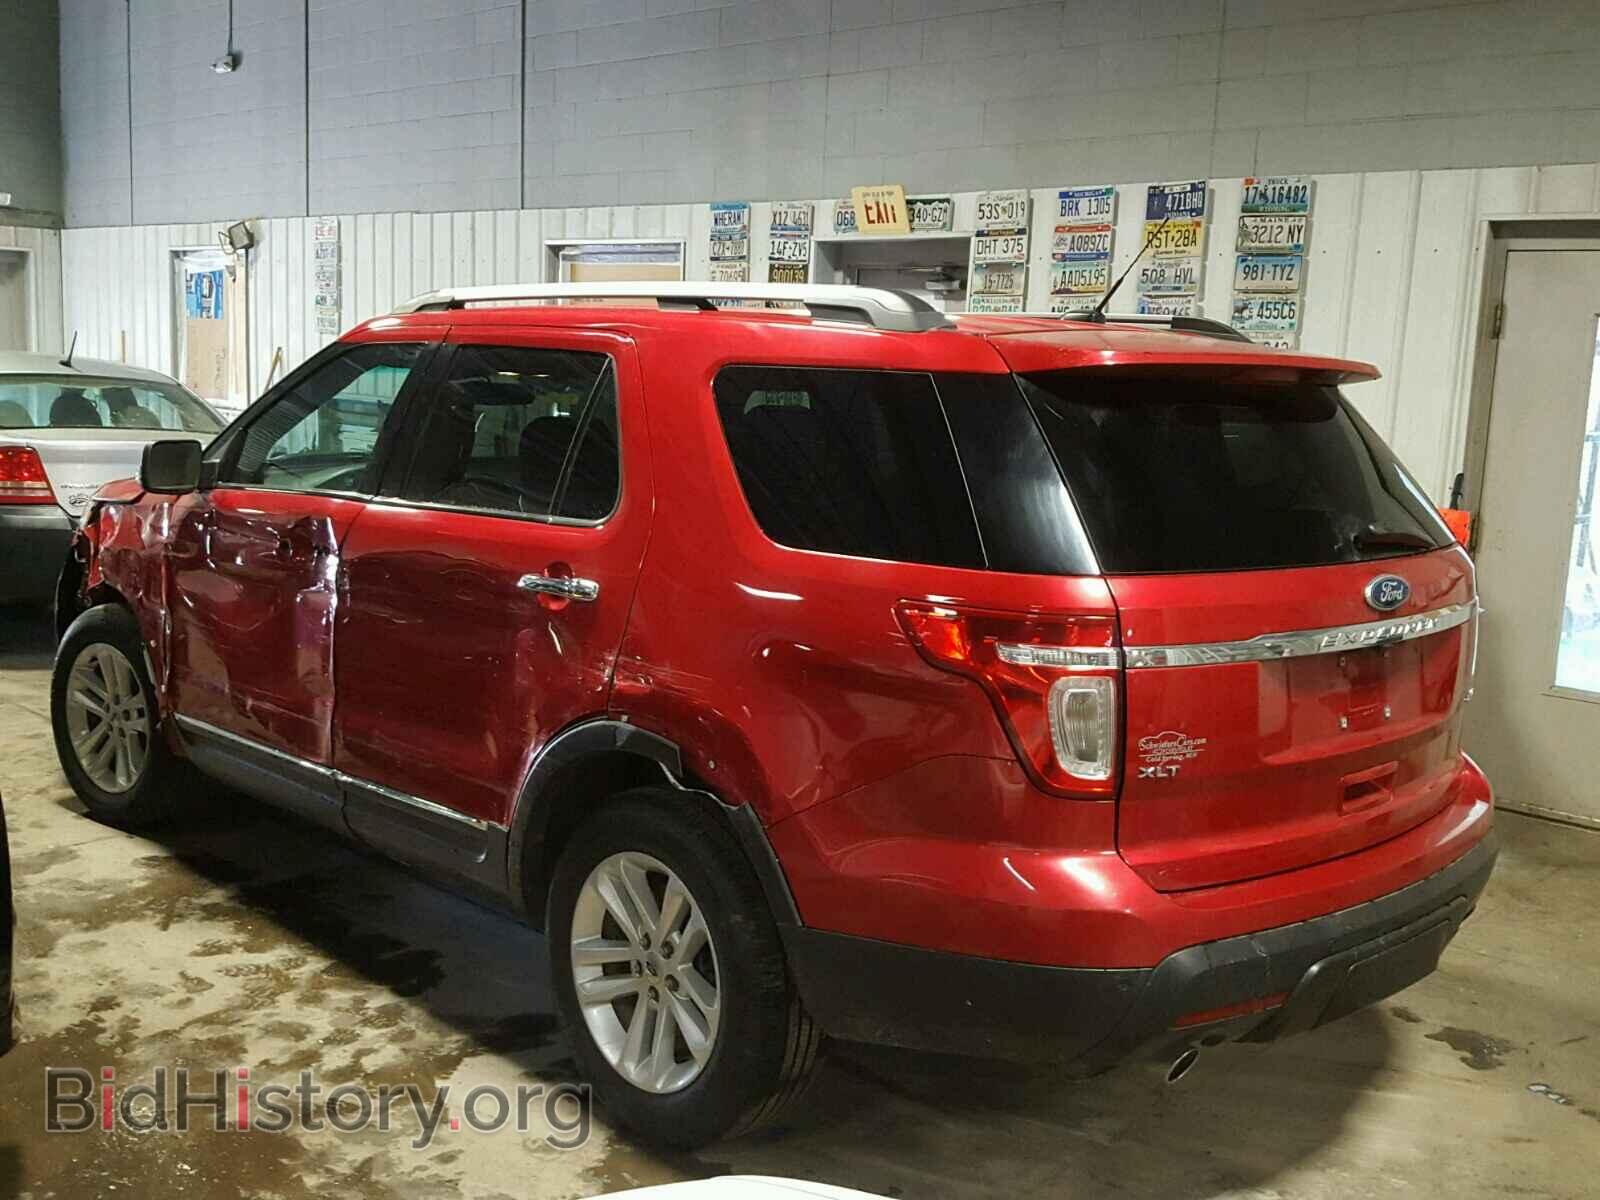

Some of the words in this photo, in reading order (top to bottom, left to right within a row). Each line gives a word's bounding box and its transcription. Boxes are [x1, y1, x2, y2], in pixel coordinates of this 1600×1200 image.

[1060, 199, 1080, 217] BRK
[1286, 224, 1304, 243] NY
[1381, 581, 1404, 602] Ford
[1137, 764, 1181, 779] XLT
